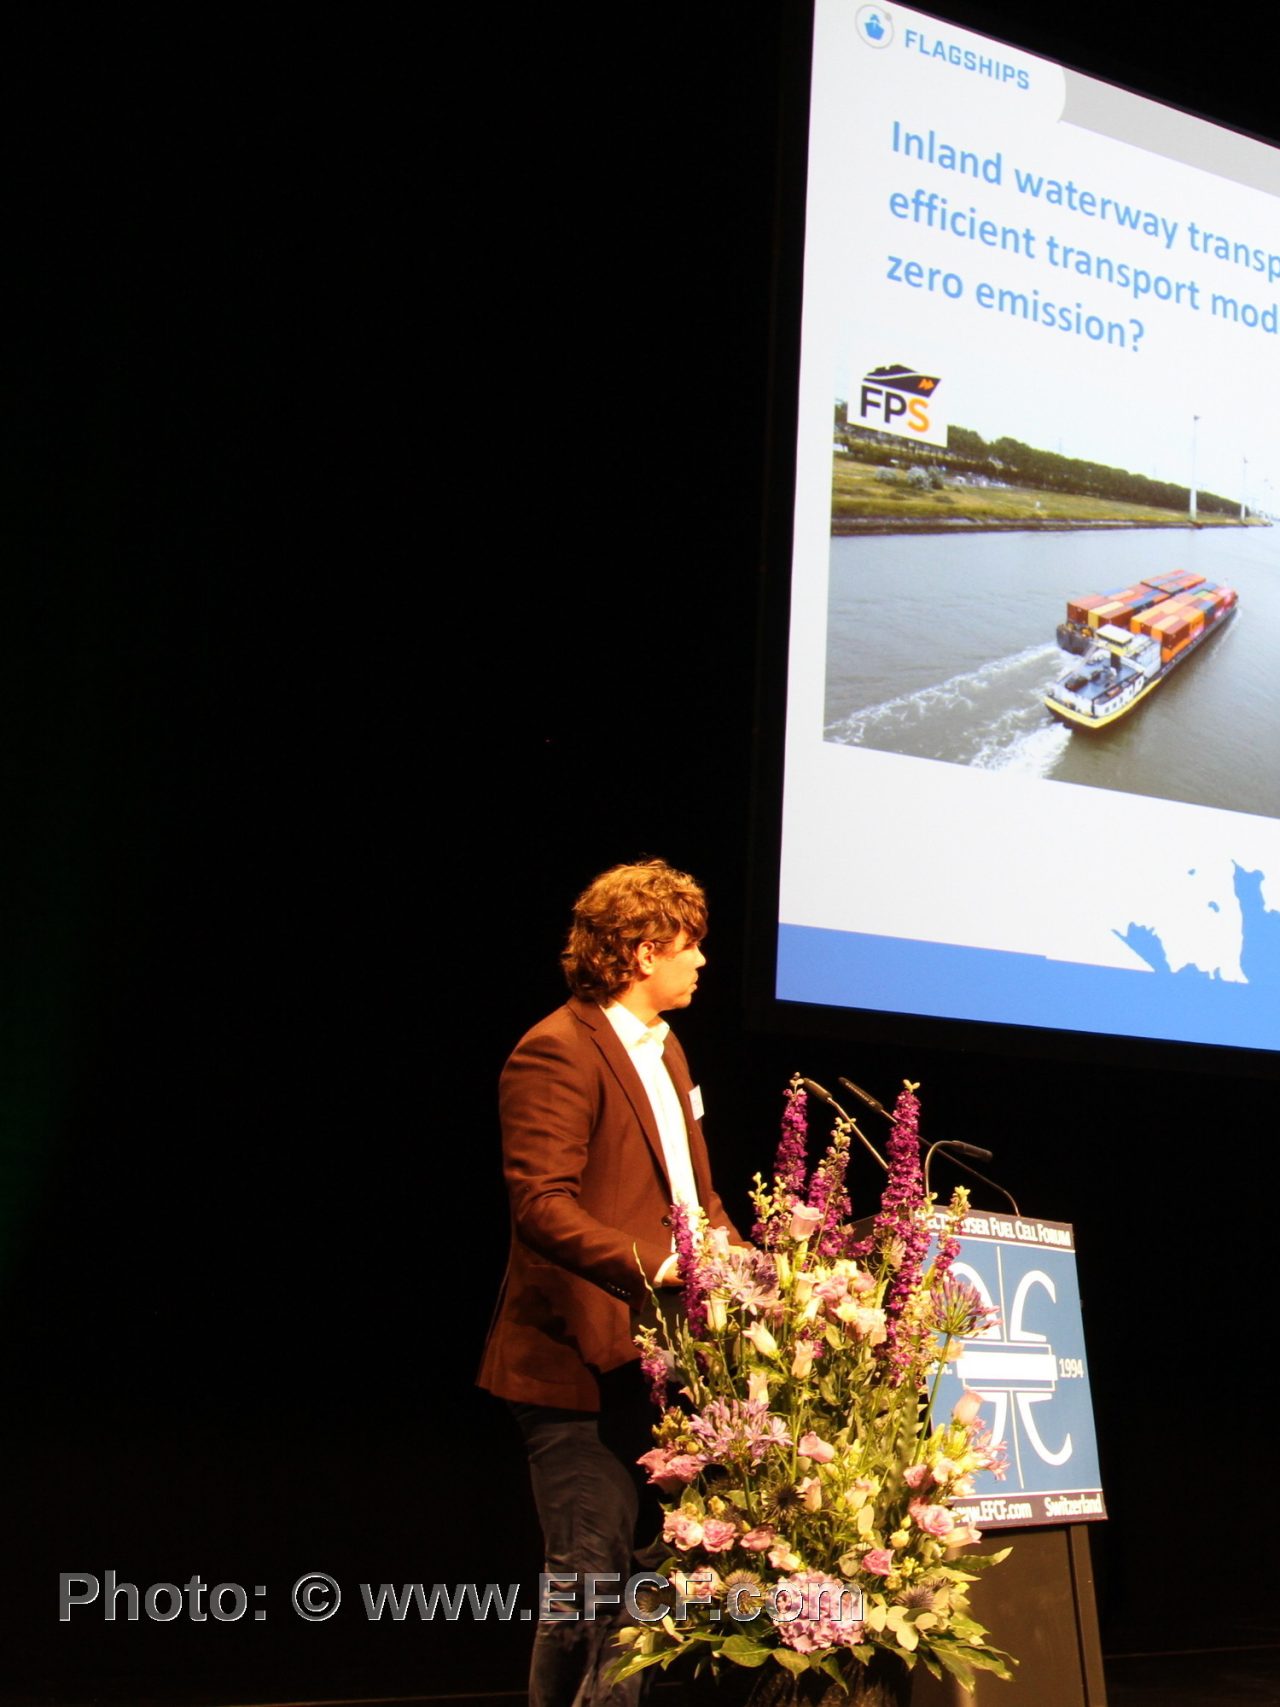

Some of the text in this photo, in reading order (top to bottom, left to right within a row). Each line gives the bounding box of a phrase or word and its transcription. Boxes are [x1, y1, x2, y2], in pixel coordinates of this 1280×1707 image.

[905, 29, 1030, 91] FLAGSHIPS
[892, 121, 1002, 186] Inland
[1014, 166, 1179, 250] waterway
[889, 188, 1036, 260] efficient
[1046, 236, 1200, 311] transport
[886, 254, 1145, 353] zero emission?
[860, 385, 930, 433] FPS
[1059, 1358, 1084, 1378] 1994
[1044, 1494, 1103, 1518] Switzerland
